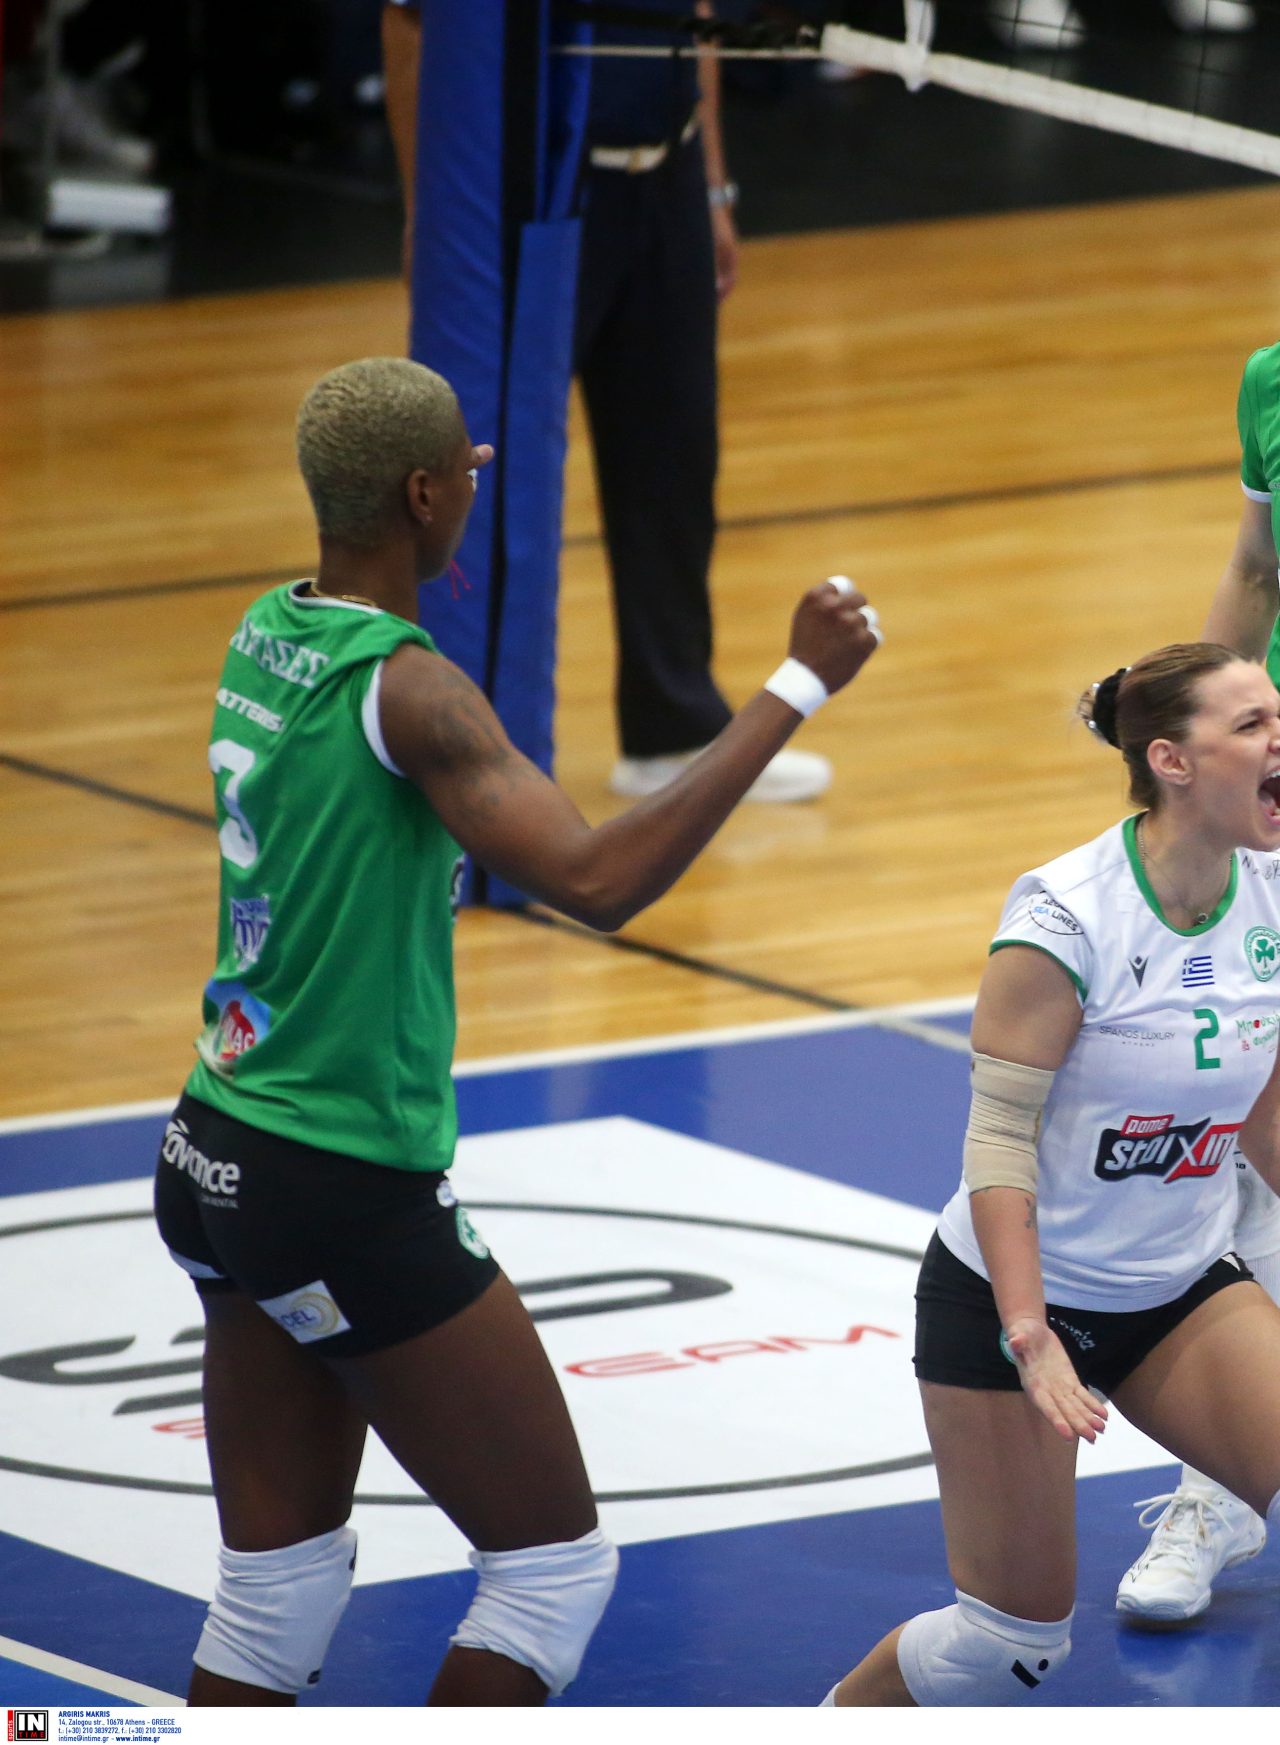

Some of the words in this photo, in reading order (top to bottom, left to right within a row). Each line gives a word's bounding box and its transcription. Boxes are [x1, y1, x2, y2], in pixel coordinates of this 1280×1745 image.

[208, 738, 258, 870] 3
[1051, 910, 1078, 931] LINES
[1100, 1025, 1138, 1039] SPANOS
[1141, 1031, 1175, 1041] LUXURY
[1193, 1008, 1220, 1070] 2
[1125, 1118, 1169, 1134] pame
[162, 1131, 240, 1195] avance
